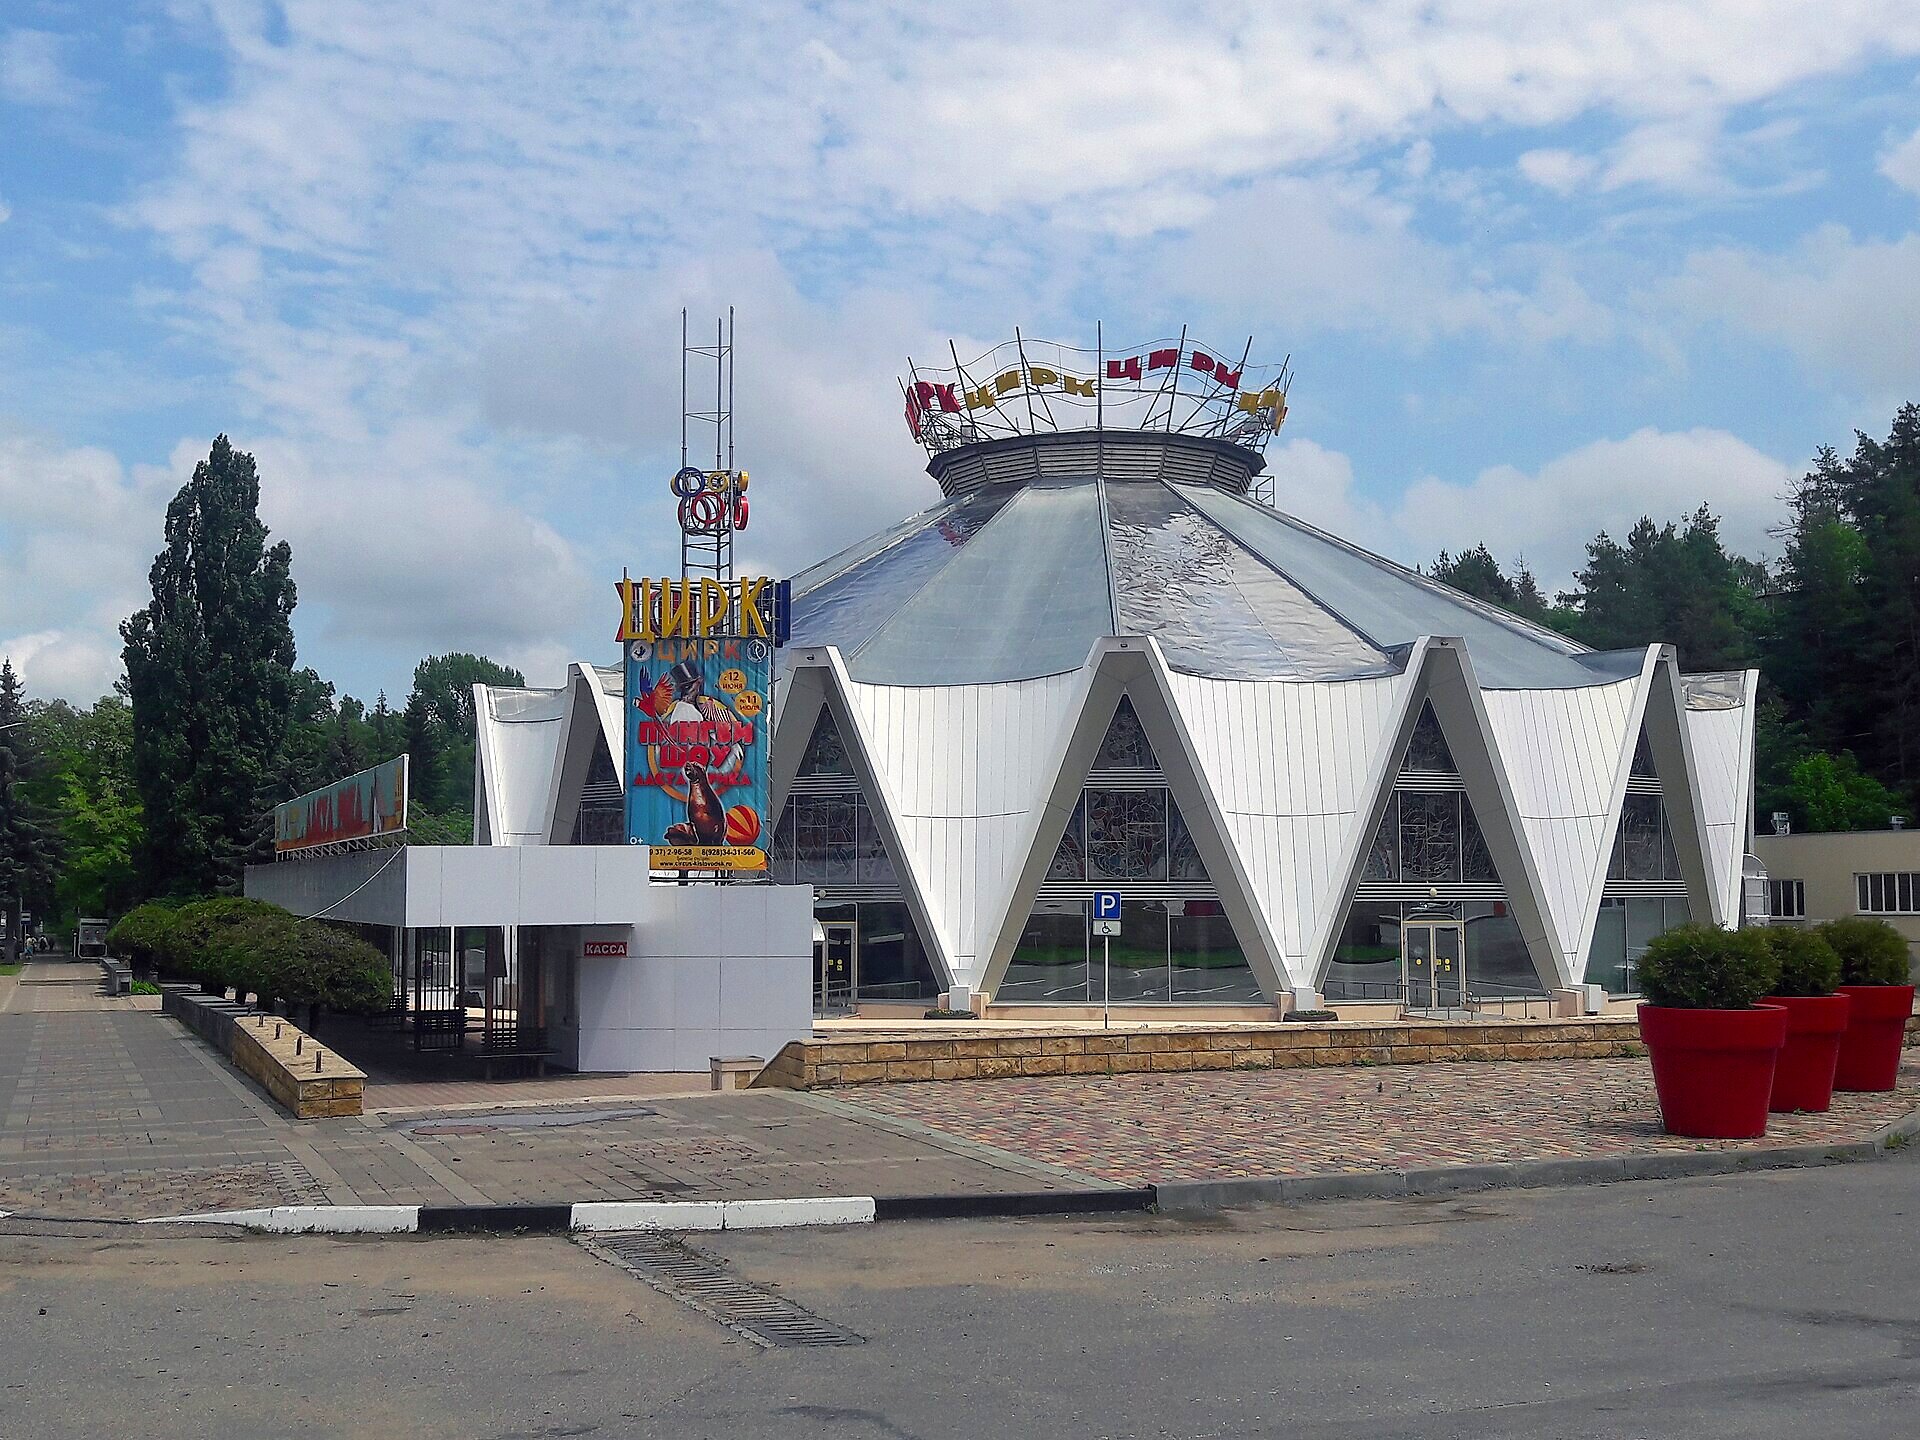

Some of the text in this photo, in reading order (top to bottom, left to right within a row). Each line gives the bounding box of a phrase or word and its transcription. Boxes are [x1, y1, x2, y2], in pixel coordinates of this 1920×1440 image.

[1106, 348, 1243, 389] ЦИРК
[965, 367, 1097, 410] ЦИРК
[624, 576, 769, 642] ЦИРК
[658, 640, 741, 662] ЦИРК
[728, 671, 740, 681] 12
[746, 695, 757, 703] 11
[660, 745, 731, 767] ШОУ
[1101, 894, 1116, 916] P
[585, 943, 625, 955] КАССА
